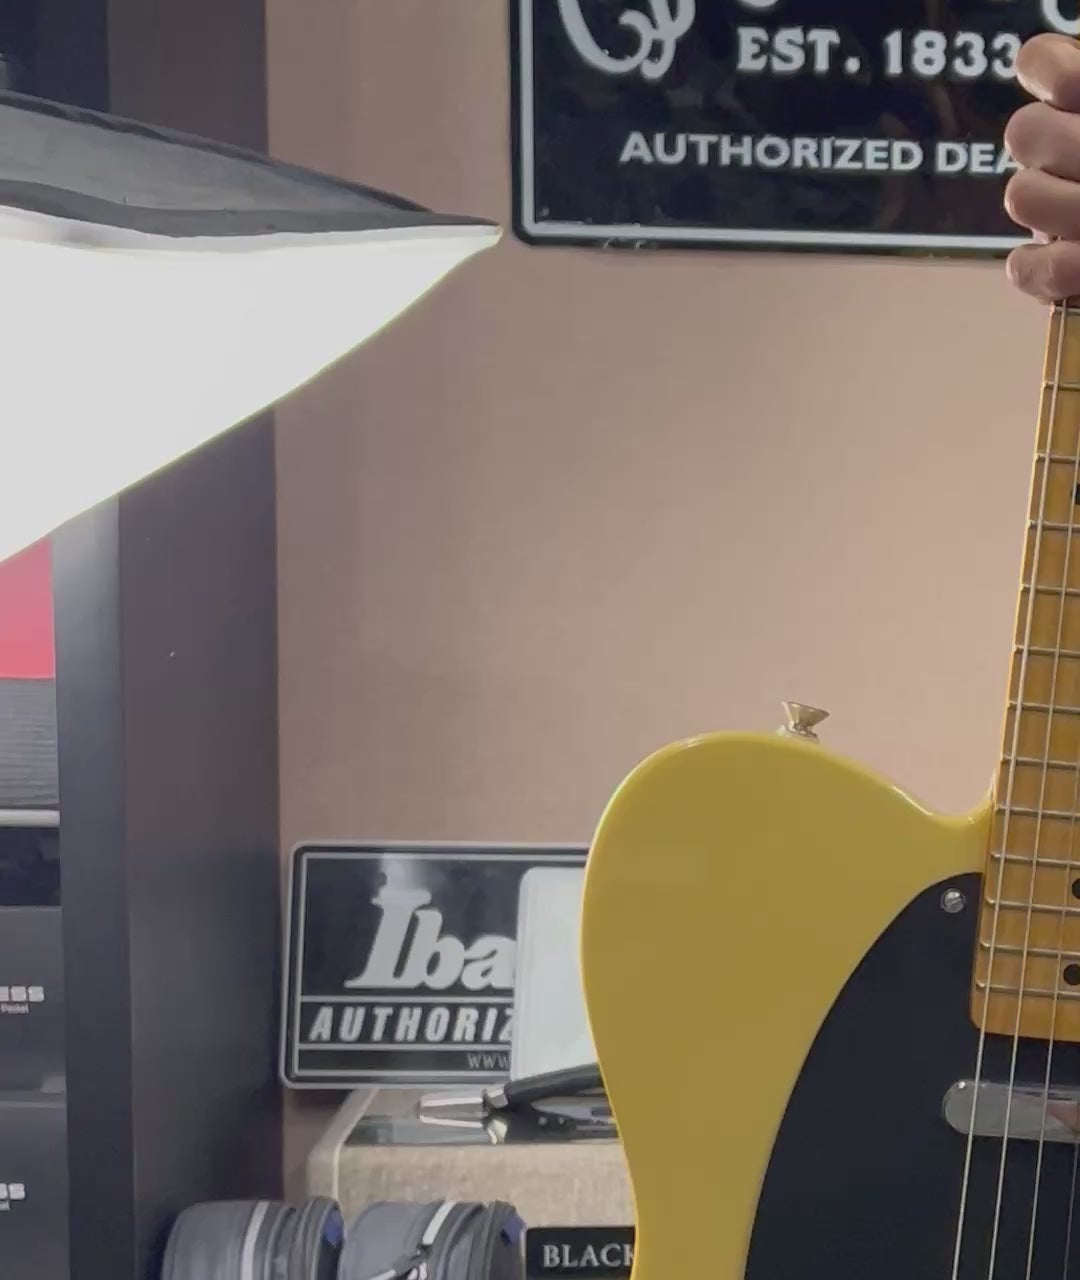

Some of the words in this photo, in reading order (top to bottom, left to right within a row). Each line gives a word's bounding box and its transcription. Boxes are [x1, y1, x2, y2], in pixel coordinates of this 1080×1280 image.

[737, 26, 861, 73] EST.
[883, 30, 1022, 78] 1833
[619, 131, 923, 172] AUTHORIZED
